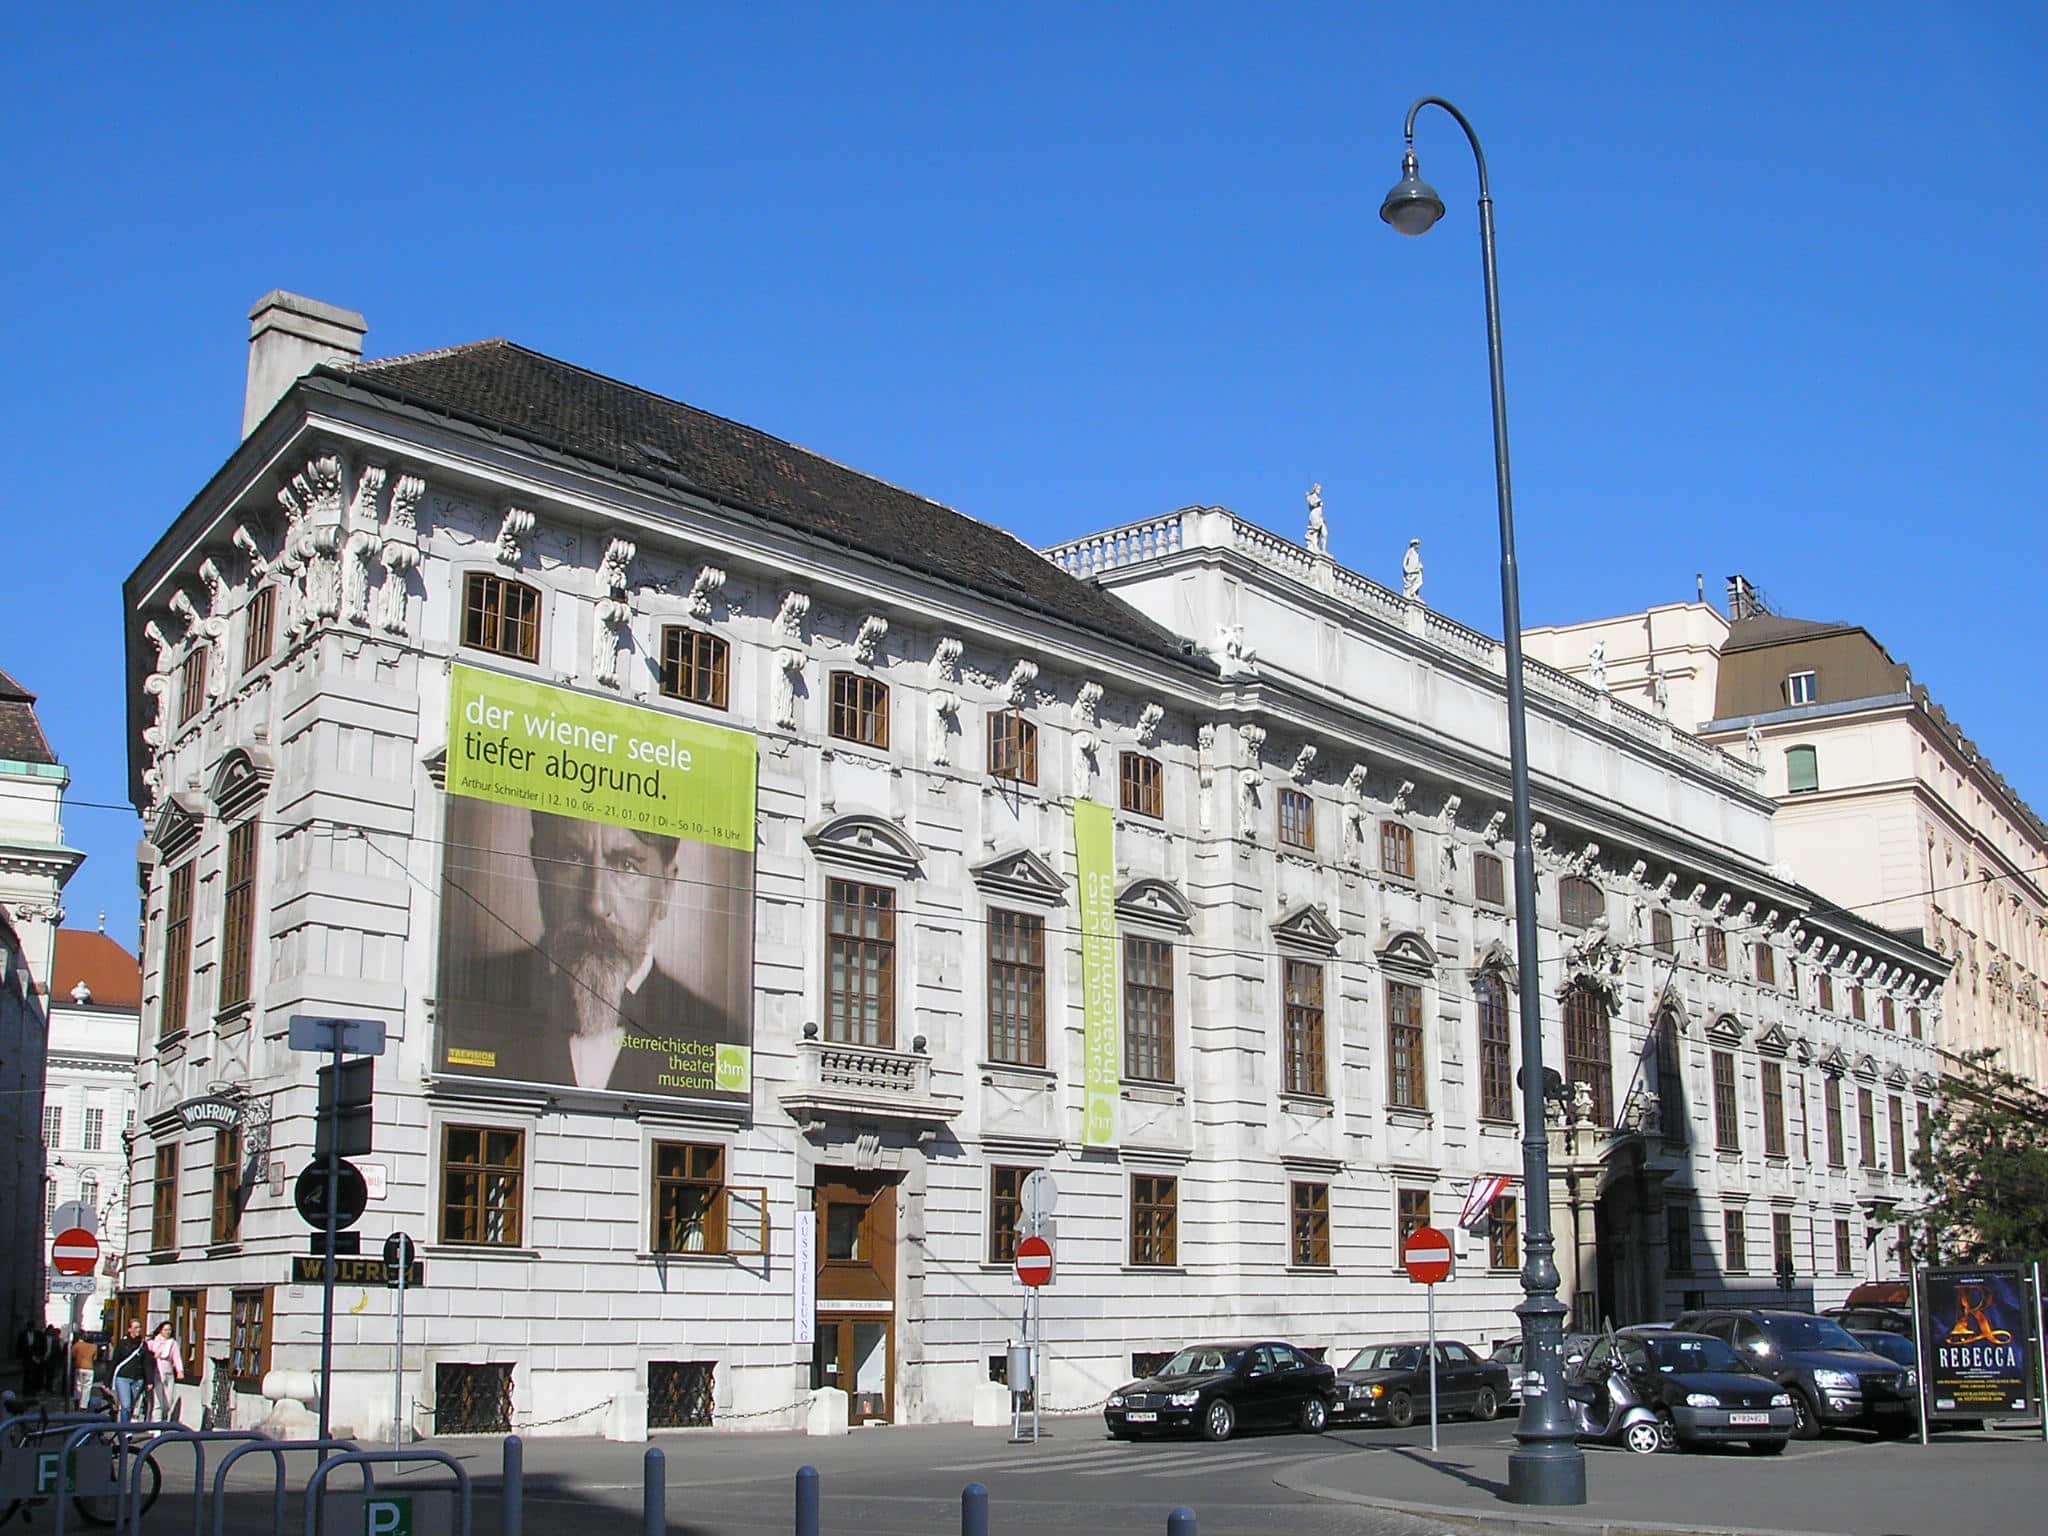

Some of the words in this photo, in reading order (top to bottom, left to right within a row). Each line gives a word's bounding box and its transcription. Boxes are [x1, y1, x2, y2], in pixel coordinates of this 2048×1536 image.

[465, 695, 514, 731] der
[524, 711, 619, 754] wiener
[628, 738, 692, 771] seele
[465, 731, 536, 771] tiefer
[545, 750, 667, 800] abgrund.
[461, 777, 491, 791] Arthur
[494, 783, 538, 801] Schnitzler
[638, 812, 650, 823] 07
[658, 816, 668, 827] Di
[679, 820, 689, 831] So
[692, 822, 703, 833] 10
[712, 826, 723, 838] 18
[725, 829, 741, 840] Uhr
[1100, 874, 1116, 1086] theatermuseum
[669, 1054, 715, 1074] theater
[717, 1060, 744, 1076] khm
[658, 1074, 715, 1090] museum
[183, 1103, 238, 1124] WOLFRUM
[800, 1215, 810, 1342] AUSSTELLUNG
[1939, 1346, 2016, 1368] REBECCA
[369, 1502, 401, 1536] P
